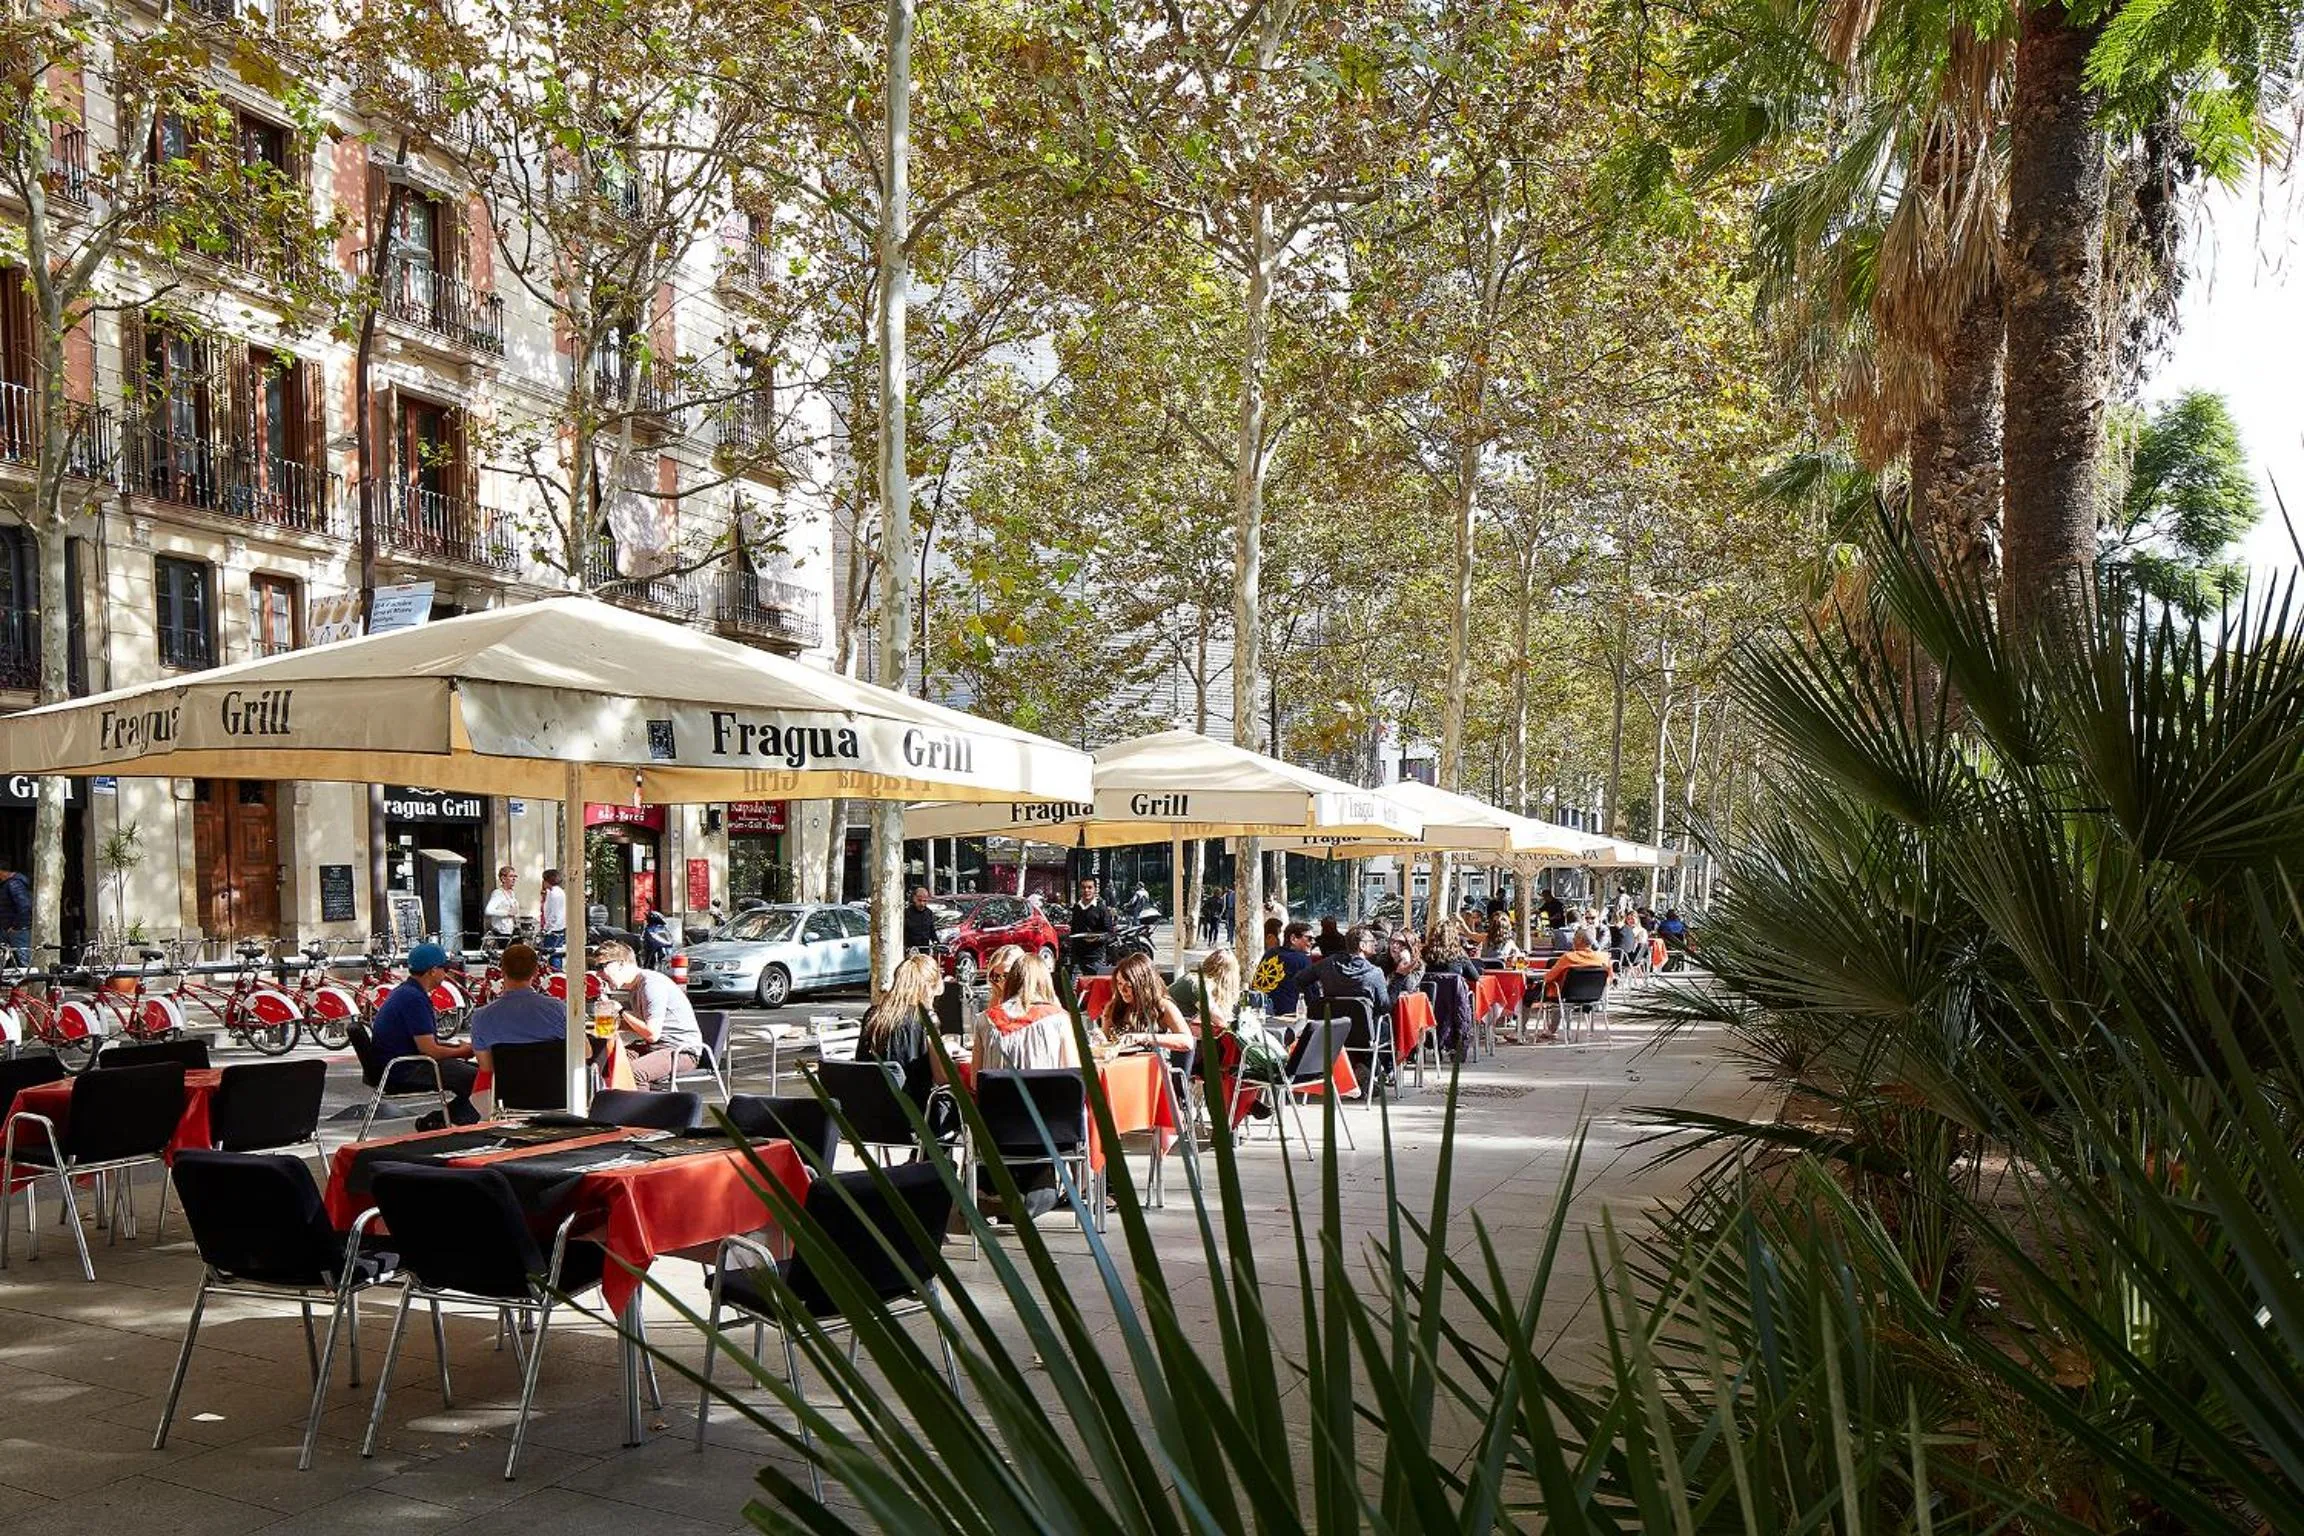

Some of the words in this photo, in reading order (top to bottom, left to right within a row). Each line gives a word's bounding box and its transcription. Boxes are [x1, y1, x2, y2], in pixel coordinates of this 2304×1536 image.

[221, 689, 293, 736] Grill
[710, 711, 859, 768] Fragua
[903, 728, 974, 773] Grill
[384, 800, 437, 819] ragua
[442, 799, 481, 818] Grill
[1131, 793, 1188, 816] Grill
